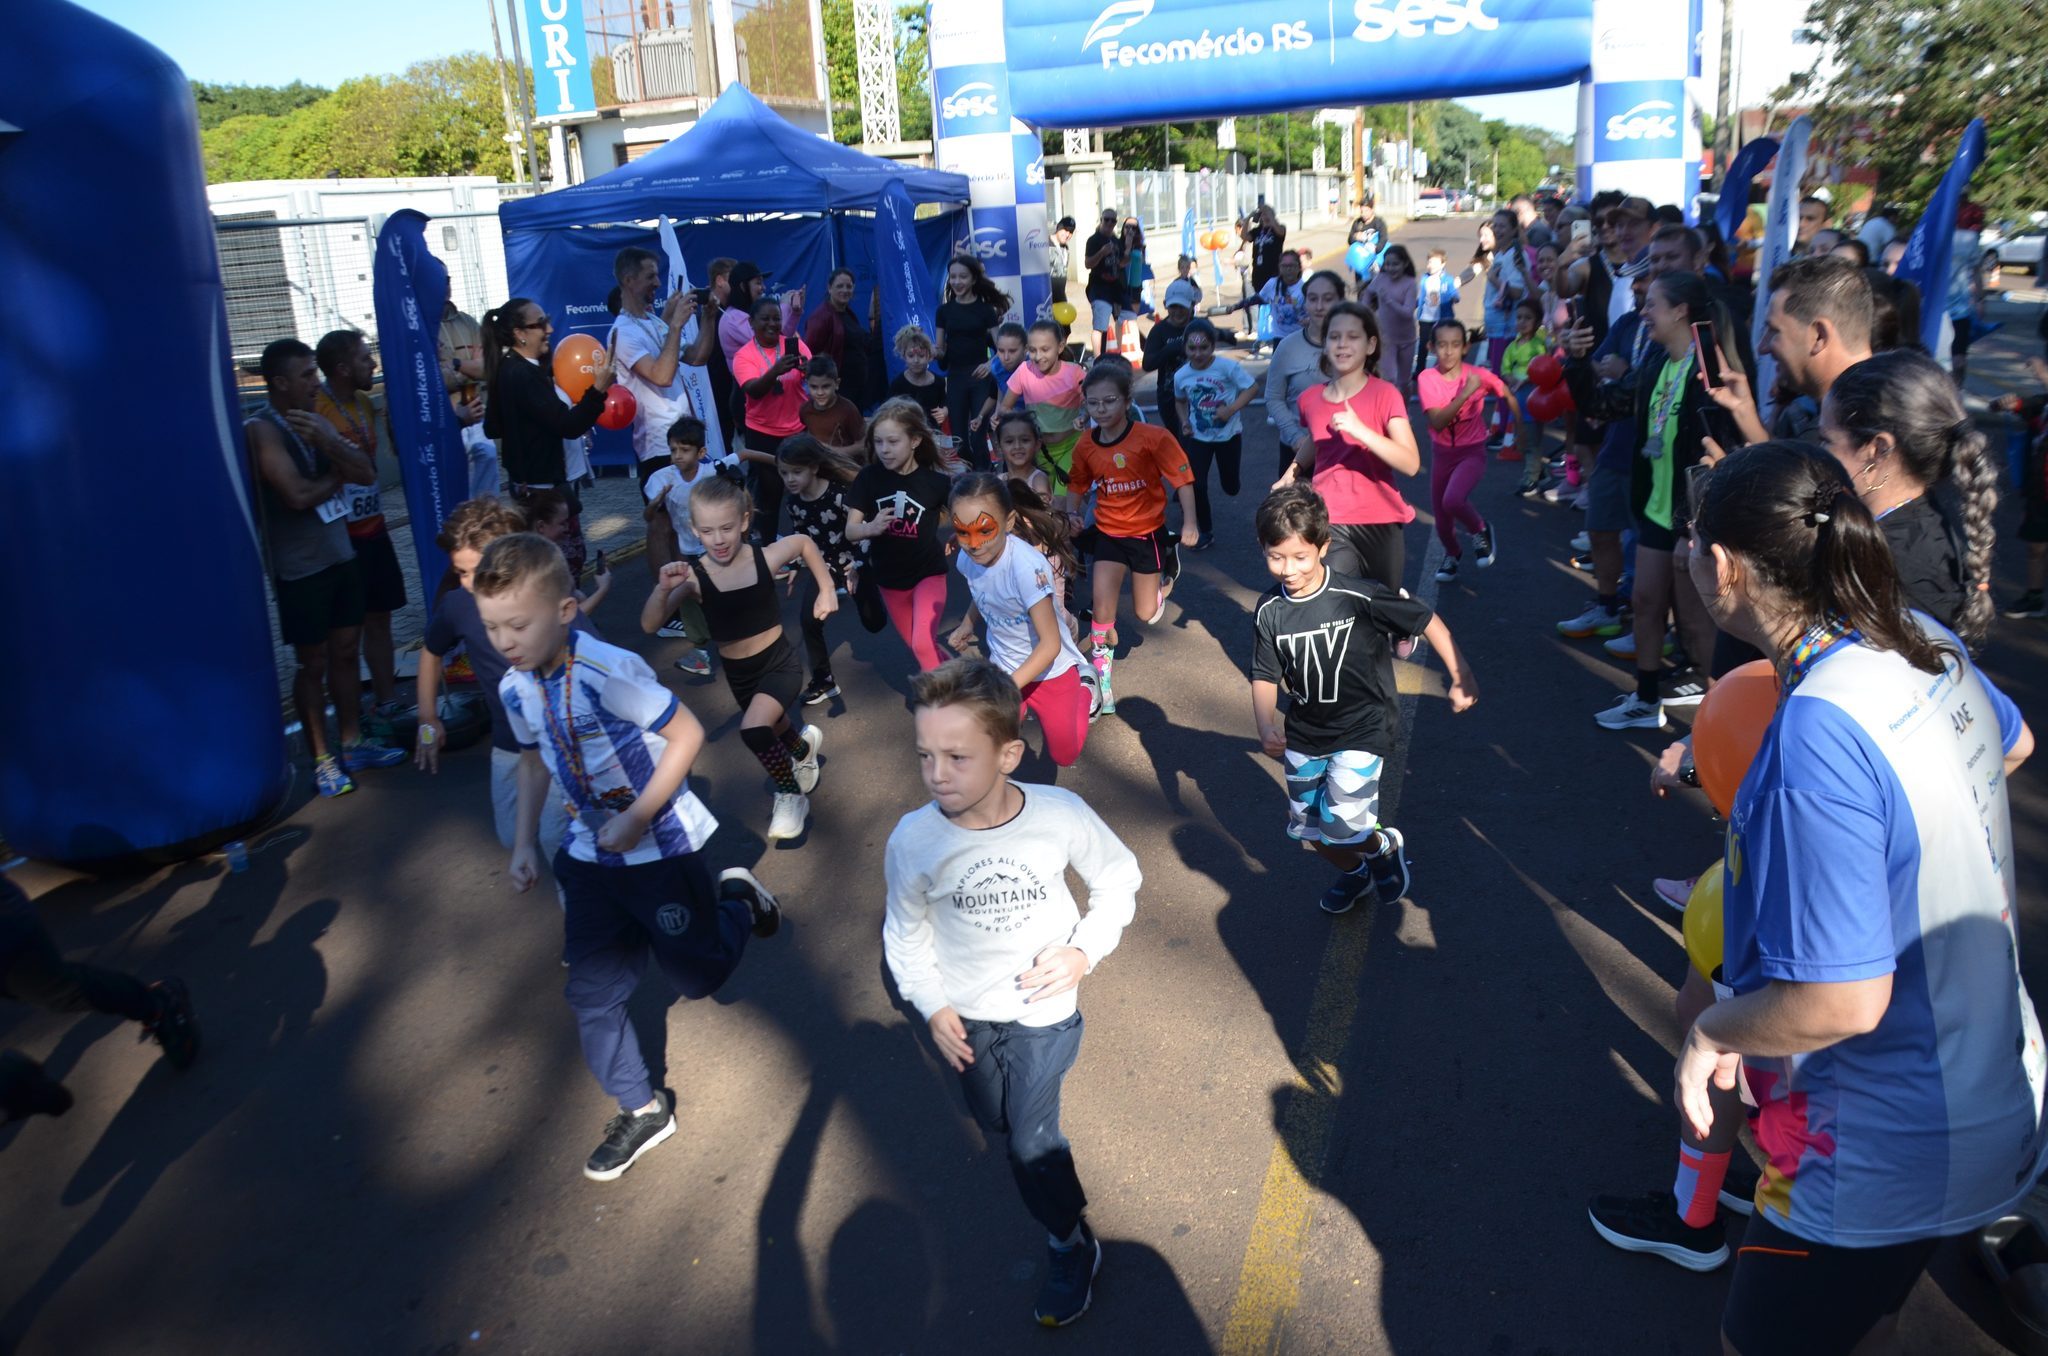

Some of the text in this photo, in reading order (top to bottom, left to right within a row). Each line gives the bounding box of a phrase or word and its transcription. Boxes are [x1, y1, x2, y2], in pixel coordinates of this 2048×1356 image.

[1100, 20, 1313, 69] Fecomércio RS
[998, 857, 1016, 867] ALL
[1020, 863, 1040, 886] OVER
[952, 885, 1047, 909] MOUNTAINS
